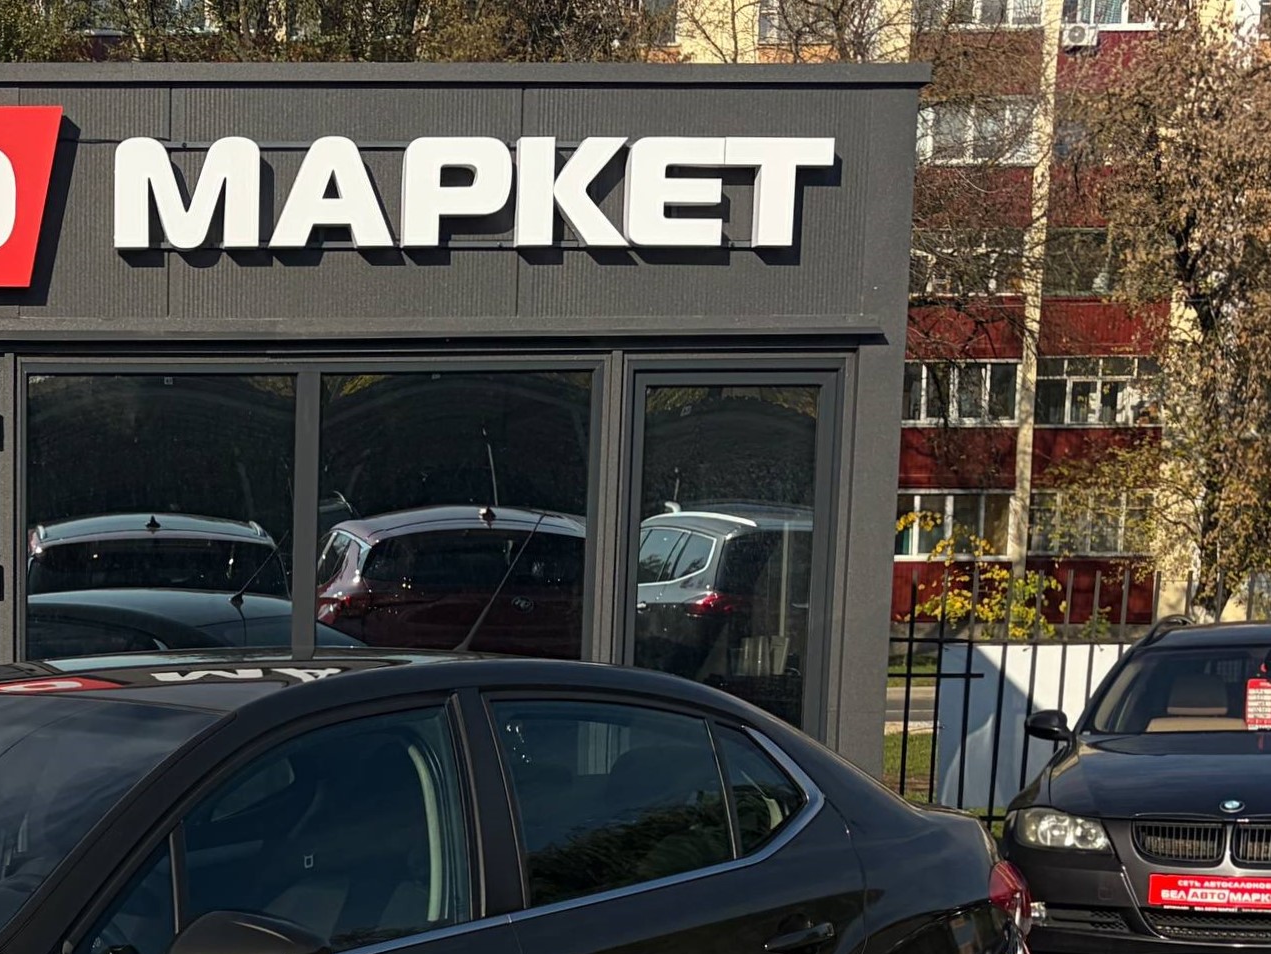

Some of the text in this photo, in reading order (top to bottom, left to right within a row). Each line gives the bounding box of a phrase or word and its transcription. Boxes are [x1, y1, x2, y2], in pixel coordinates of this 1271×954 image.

[114, 136, 835, 249] МАРКЕТ
[1161, 889, 1187, 900] БЕЛ
[1191, 891, 1227, 901] АВТО
